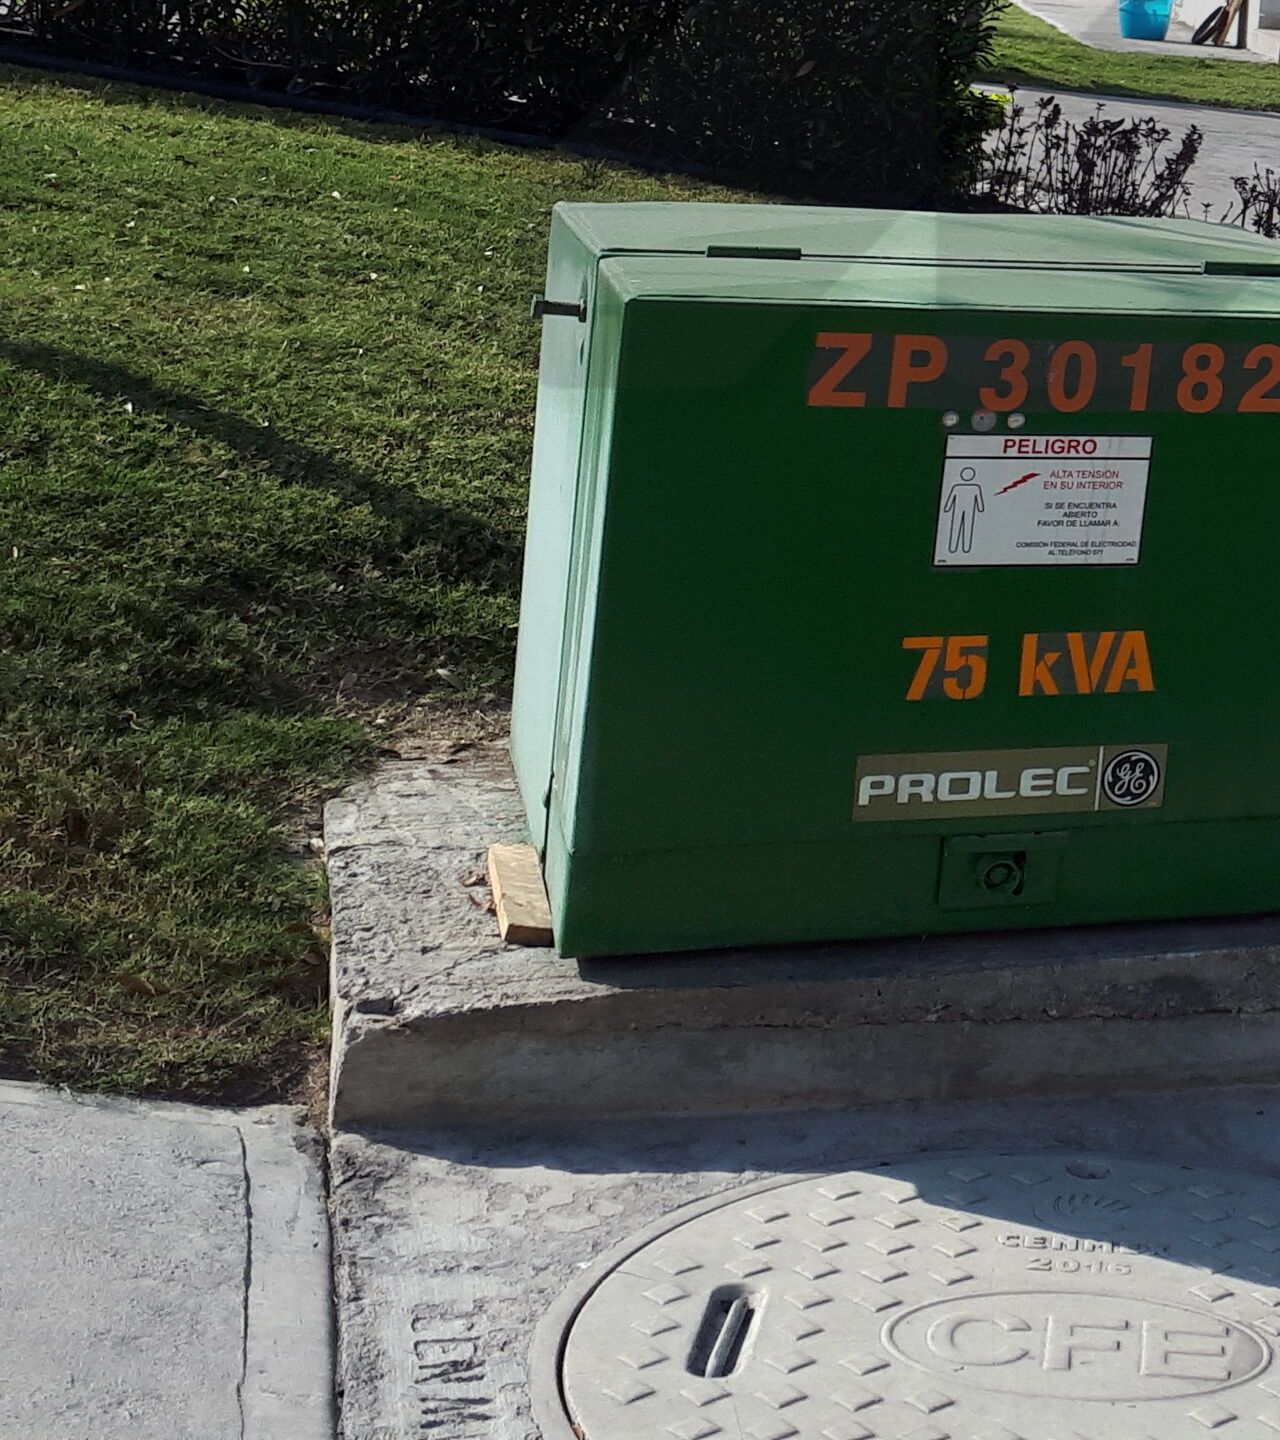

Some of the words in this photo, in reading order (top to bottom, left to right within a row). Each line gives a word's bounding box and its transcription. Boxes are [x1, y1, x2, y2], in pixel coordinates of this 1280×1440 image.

[807, 331, 948, 409] ZP
[1002, 438, 1098, 455] PELIGRO
[1043, 481, 1057, 490] EN
[1060, 481, 1074, 490] SU
[1076, 481, 1124, 490] INTERIOR
[1049, 470, 1073, 479] ALTA
[1076, 469, 1120, 479] TENSIÓN
[1055, 502, 1066, 510] SE
[1067, 502, 1118, 510] ENCUENTRA
[900, 636, 989, 702] 75
[1018, 629, 1156, 697] kVA
[857, 765, 1091, 807] PROLEC
[926, 1312, 1231, 1383] CFE
